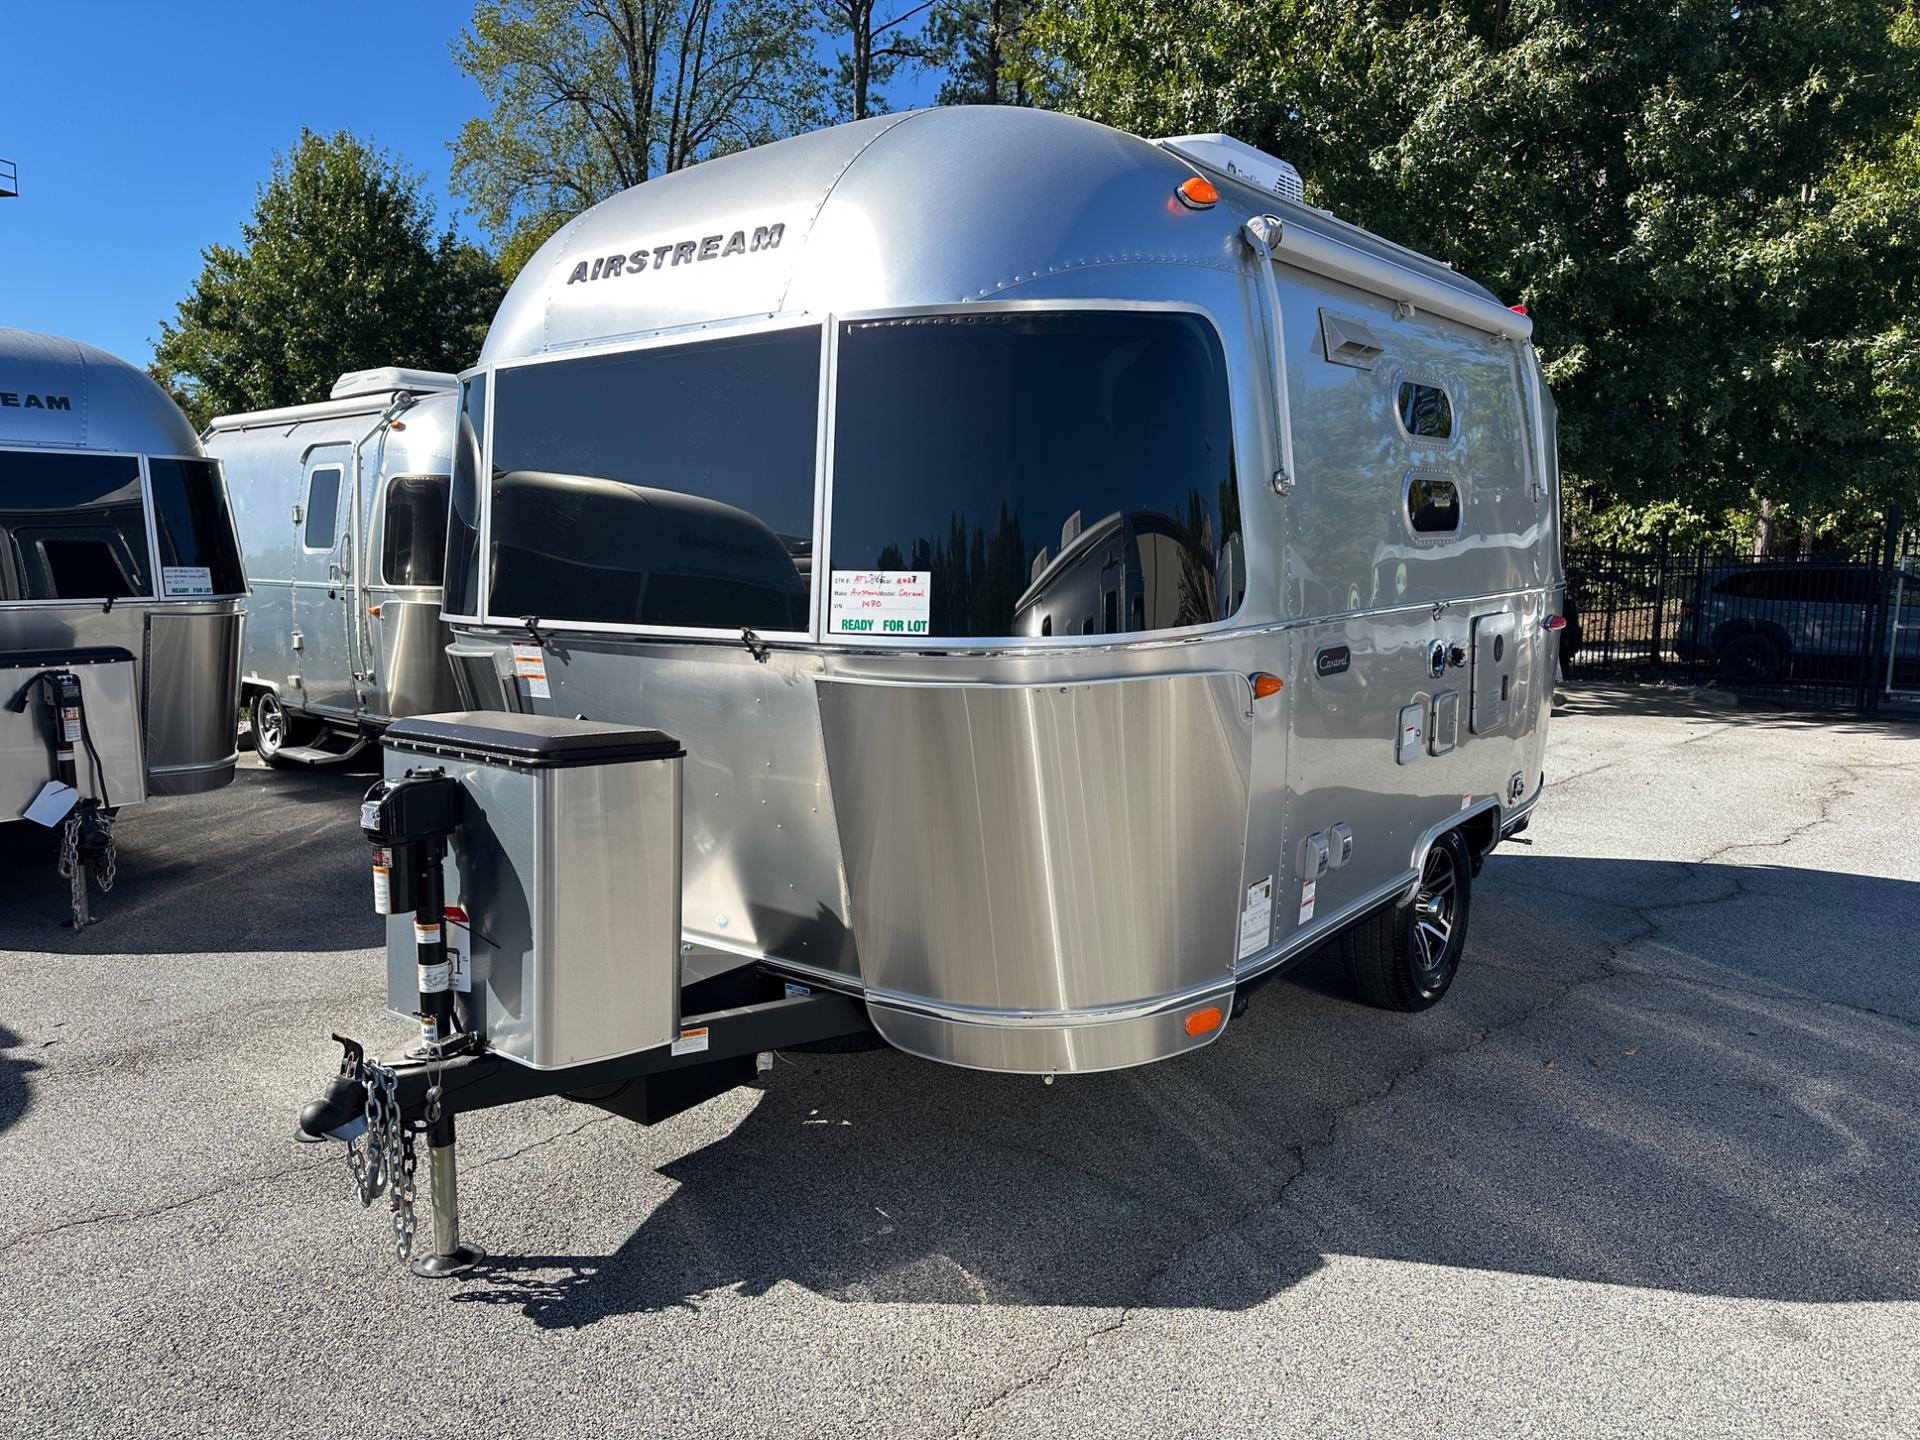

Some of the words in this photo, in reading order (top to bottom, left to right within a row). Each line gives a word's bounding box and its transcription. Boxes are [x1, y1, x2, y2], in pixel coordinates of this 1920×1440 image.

[567, 222, 786, 285] AIRSTREAM
[0, 392, 72, 411] EAM
[841, 618, 874, 631] READY
[883, 619, 905, 632] FOR
[907, 620, 928, 632] LOT
[1319, 650, 1348, 669] Caravel
